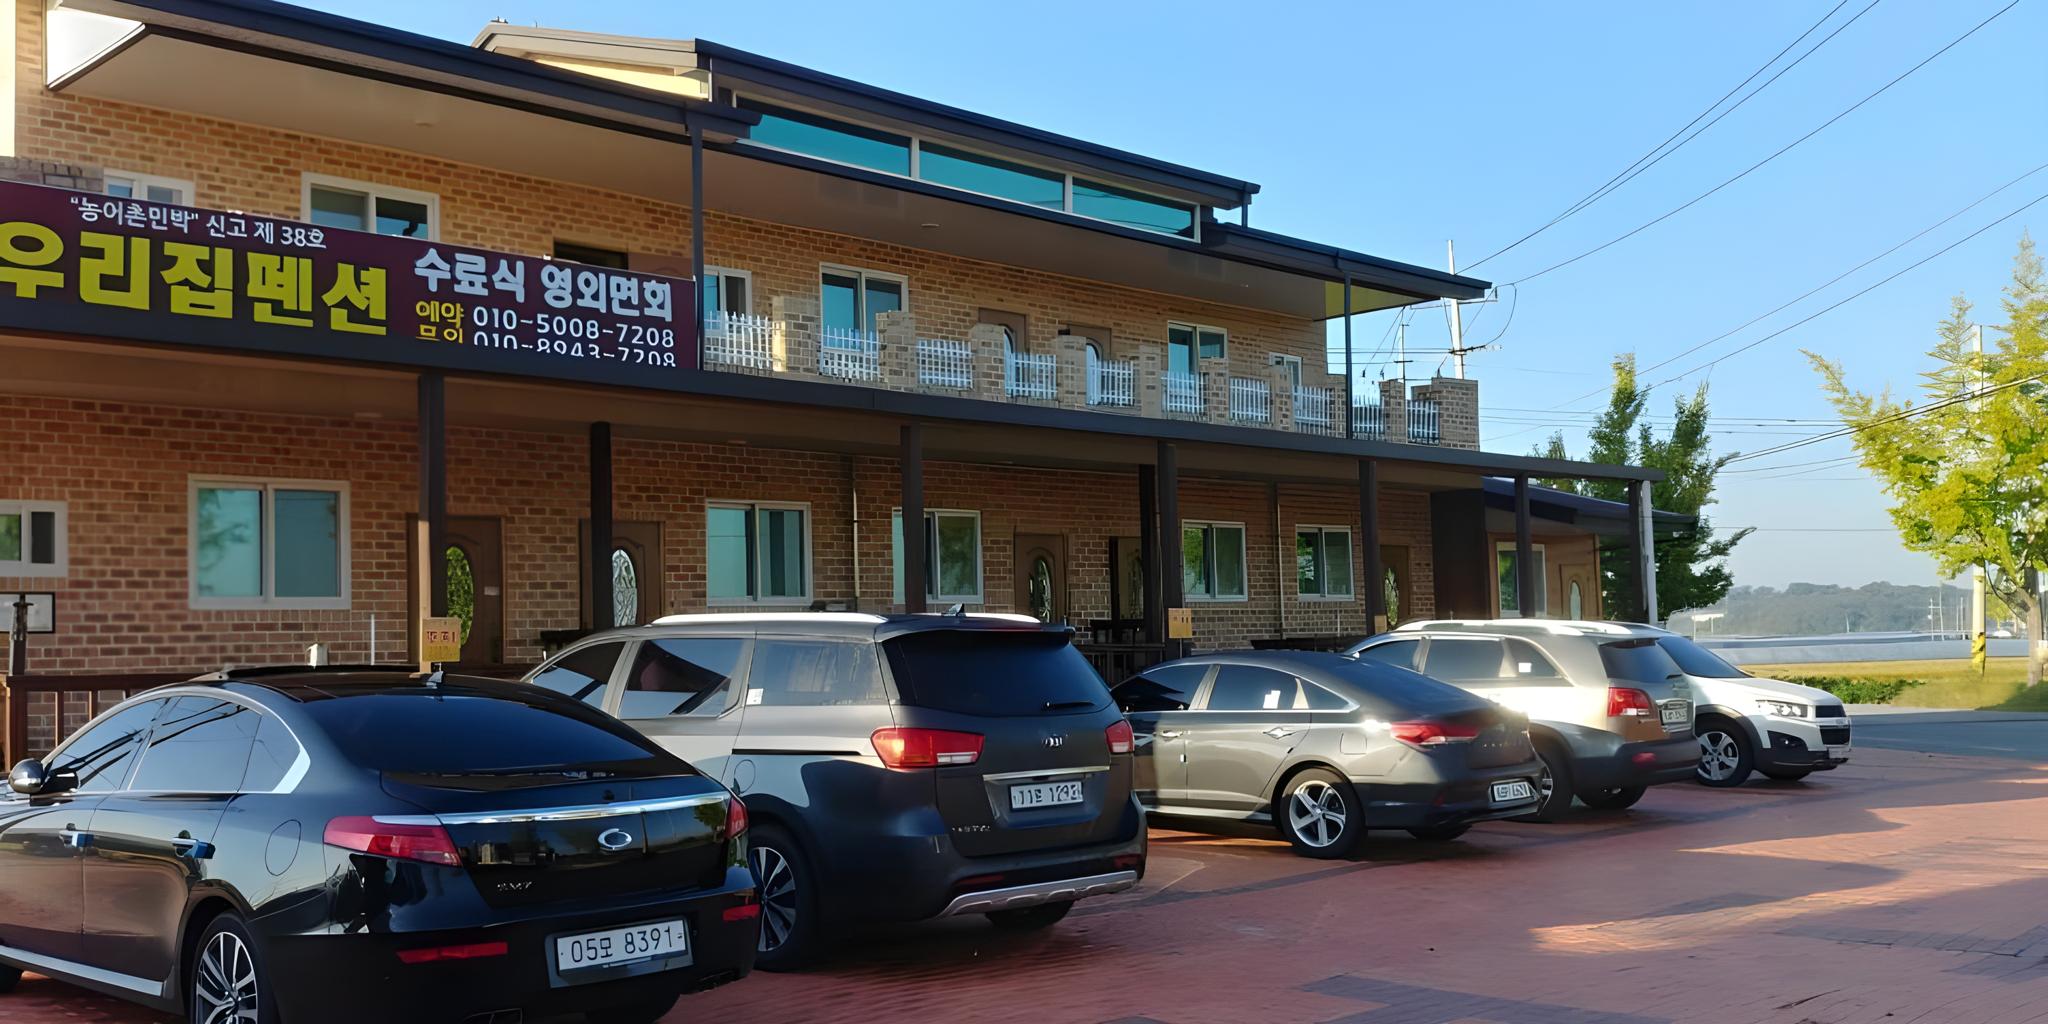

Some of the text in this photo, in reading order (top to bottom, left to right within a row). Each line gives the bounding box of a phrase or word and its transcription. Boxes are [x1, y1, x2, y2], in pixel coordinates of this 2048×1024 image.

[206, 214, 248, 238] 신고
[253, 220, 274, 244] 제
[280, 226, 327, 249] 38호
[0, 221, 387, 336] 우리집펜션
[414, 247, 673, 322] 수료식 영외면회
[415, 301, 675, 348] 예약 010-5008-7208
[571, 925, 672, 963] 05모 8391
